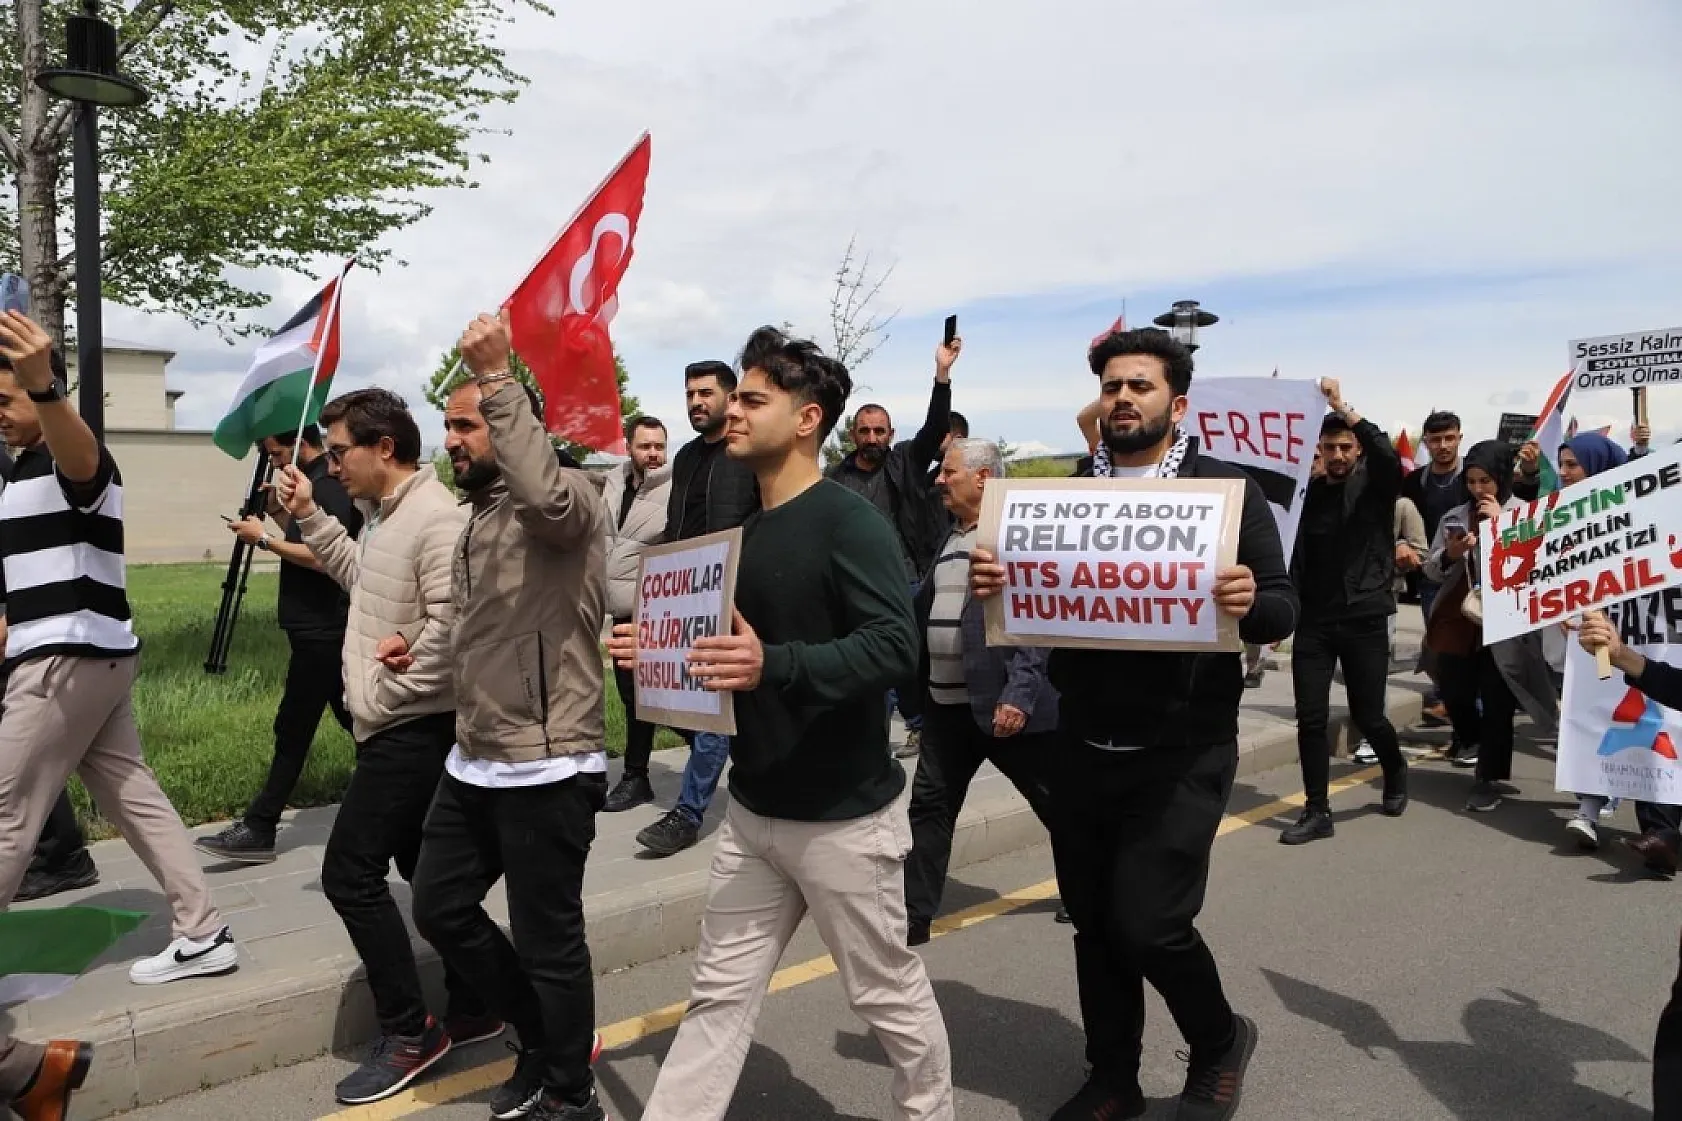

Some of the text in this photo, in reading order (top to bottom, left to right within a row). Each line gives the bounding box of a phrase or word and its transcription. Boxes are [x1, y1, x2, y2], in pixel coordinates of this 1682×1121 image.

[1576, 337, 1634, 358] Sessiz
[1578, 371, 1625, 388] Ortak
[1197, 411, 1305, 464] FREE
[1008, 502, 1213, 521] ITS NOT ABOUT
[1004, 524, 1209, 557] RELIGION,
[1545, 512, 1631, 557] KATİLİN
[1529, 523, 1657, 585] PARMAK İZİ
[642, 562, 723, 608] ÇOCUKLAR
[1006, 561, 1205, 590] ITS ABOUT
[1529, 556, 1665, 625] İSRAİL
[1011, 594, 1204, 626] HUMANITY
[638, 611, 718, 649] ÖLÜRKEN
